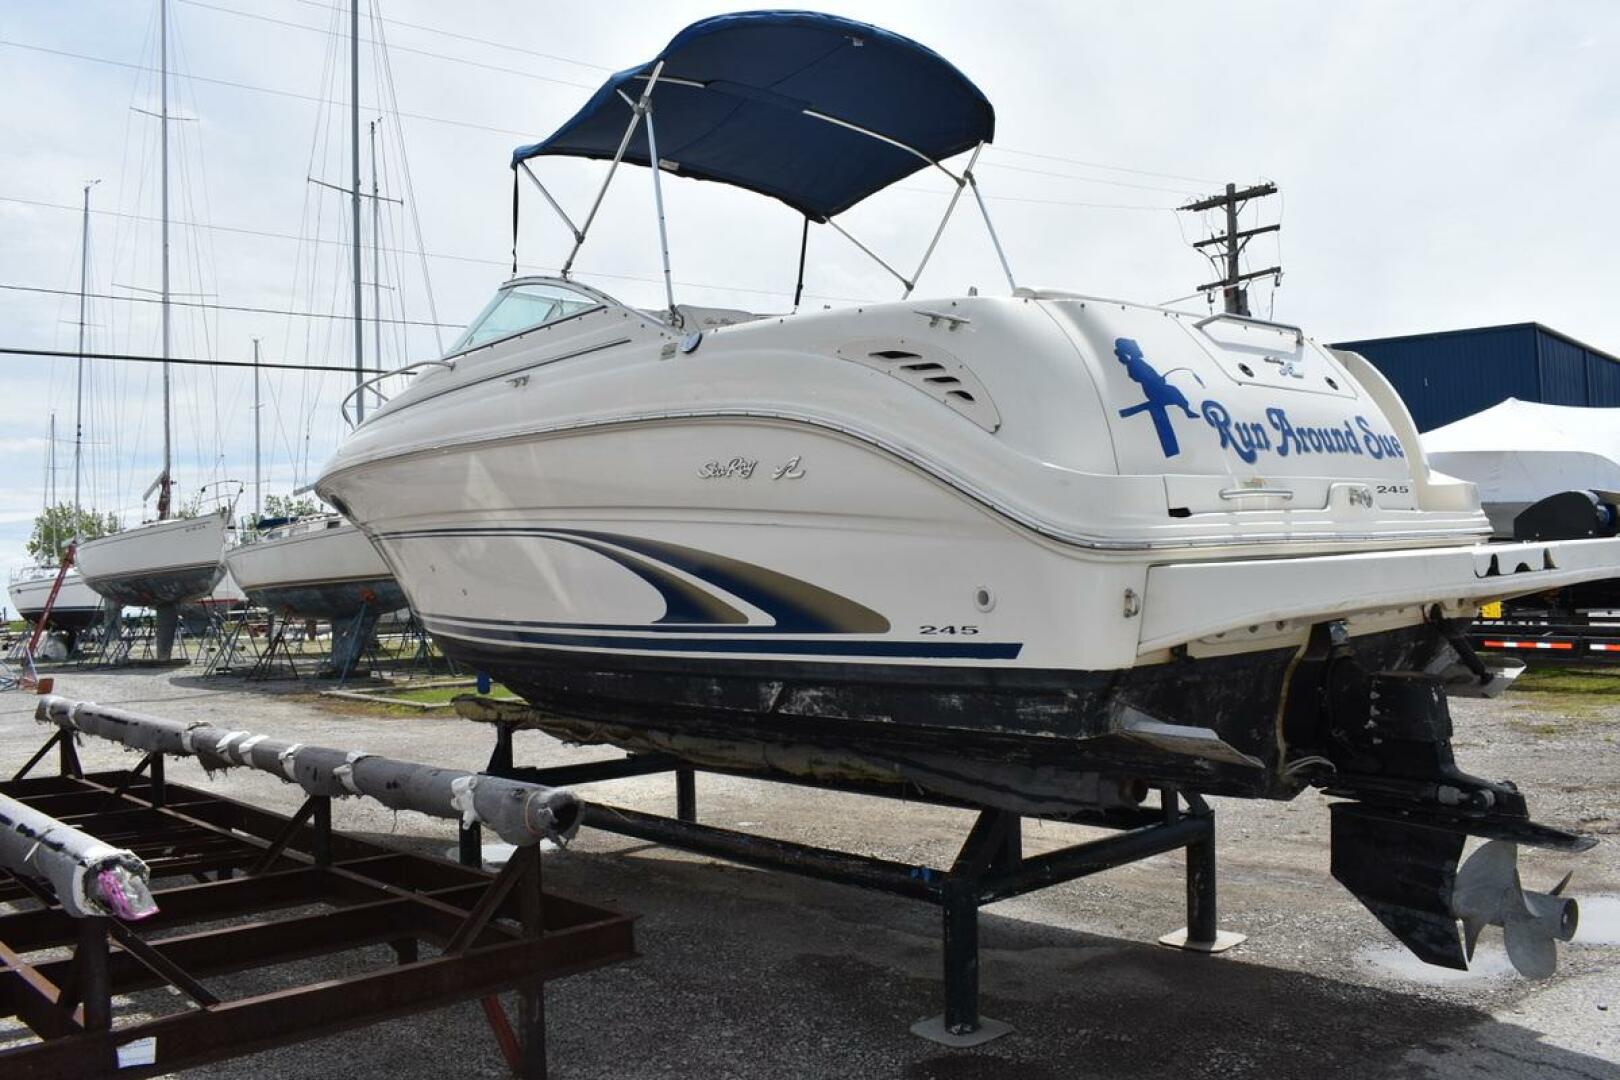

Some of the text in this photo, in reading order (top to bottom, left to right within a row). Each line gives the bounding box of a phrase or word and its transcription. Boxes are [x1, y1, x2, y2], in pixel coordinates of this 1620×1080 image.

[1201, 400, 1404, 465] Run Around Sue
[1376, 485, 1409, 494] 245
[919, 625, 979, 635] 245
